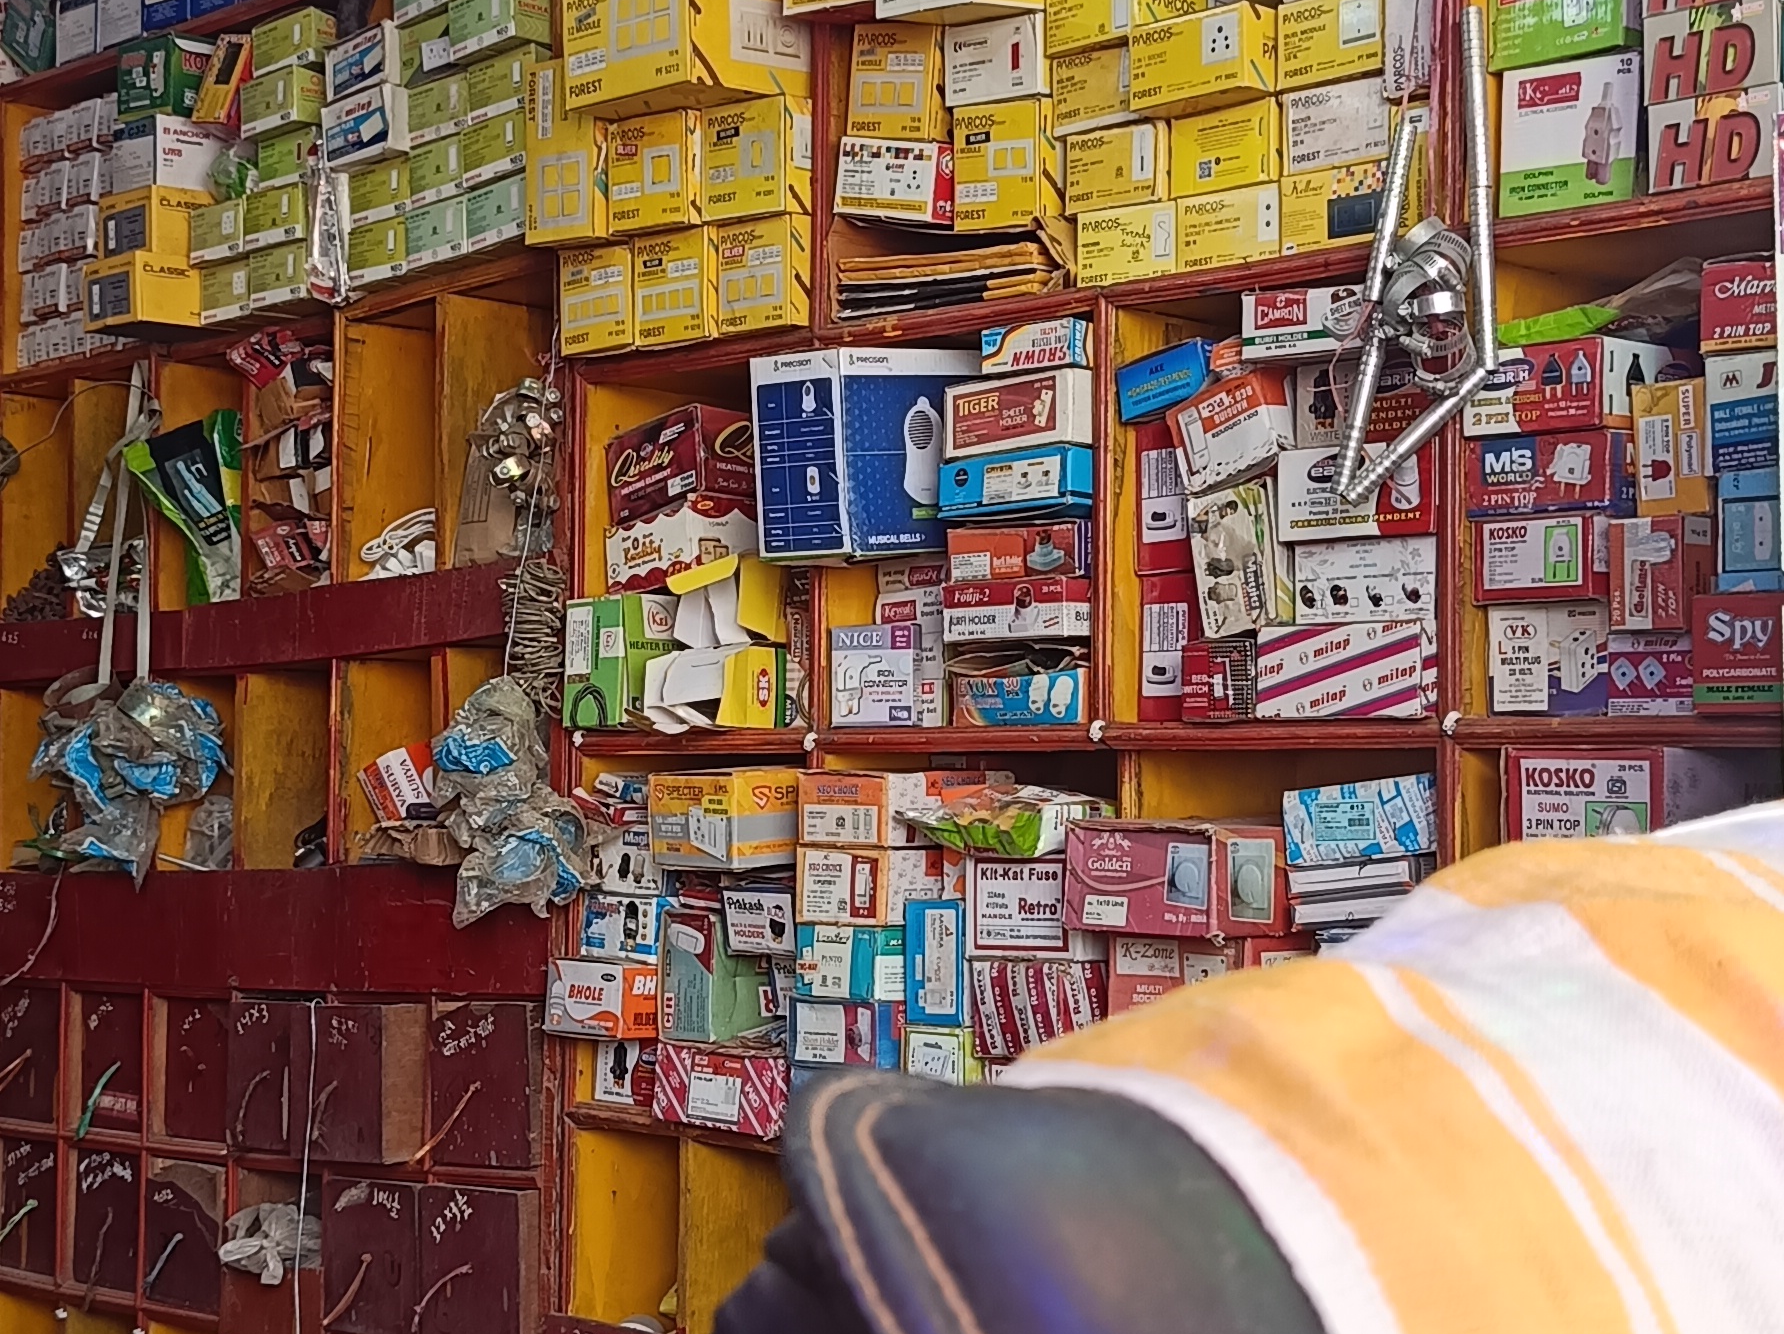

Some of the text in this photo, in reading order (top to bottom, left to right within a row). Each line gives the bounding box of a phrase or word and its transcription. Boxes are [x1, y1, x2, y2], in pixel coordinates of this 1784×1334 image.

[517, 0, 549, 14] SHIKHA
[1282, 5, 1324, 25] PARCOS
[496, 26, 509, 36] NEO
[567, 25, 575, 37] 12
[1132, 26, 1173, 47] PARCOS
[857, 33, 897, 46] PARCOS
[1619, 58, 1633, 67] 10
[1650, 22, 1755, 105] HD
[1284, 65, 1314, 79] FOREST
[569, 78, 603, 99] FOREST
[1132, 86, 1162, 101] FOREST
[527, 71, 537, 124] FOREST
[345, 97, 373, 118] milap
[851, 121, 882, 133] FOREST
[954, 114, 995, 131] PARCOS
[173, 128, 211, 142] ANCHOR
[1655, 110, 1761, 190] HD
[510, 154, 524, 165] NEO
[1292, 151, 1321, 165] FOREST
[1523, 170, 1554, 181] DOLPHIN
[1509, 180, 1569, 195] IRON CONNECTOR
[1583, 190, 1614, 200] DOLPHIN
[394, 201, 407, 212] NEO
[1184, 200, 1225, 216] PARCOS
[1082, 218, 1121, 233] PARCOS
[390, 263, 403, 274] NEO
[1184, 256, 1213, 268] FOREST
[143, 263, 191, 278] CLASSIC
[1080, 274, 1108, 285] FOREST
[1257, 303, 1304, 326] CAMRON
[1330, 302, 1348, 316] SHEET
[1713, 322, 1771, 339] 2 PIN TOP
[1255, 332, 1309, 345] BURFI HOLDER
[781, 358, 812, 370] PRECISION
[856, 354, 889, 364] PRECISION
[956, 392, 999, 417] TIGER
[1201, 395, 1226, 415] P.C.
[1372, 397, 1412, 408] MULTI
[1681, 388, 1691, 426] SUPER
[1002, 406, 1025, 418] SHEET
[1472, 410, 1541, 426] 2 PIN TOP
[1000, 414, 1028, 427] HOLDER
[1309, 429, 1340, 440] WHITE
[716, 462, 748, 474] HEATING
[1486, 472, 1532, 483] WORLD
[1482, 492, 1537, 508] 2 PIN TOP
[1290, 511, 1422, 529] PREMIUM PENDENT
[868, 533, 921, 545] MUSICAL BELLS
[1488, 525, 1528, 541] KOSKO
[1668, 590, 1677, 616] TOP
[968, 614, 997, 626] HOLDER
[1707, 611, 1773, 649] Spy
[629, 639, 661, 651] HEATER
[838, 631, 883, 647] NICE
[1643, 636, 1679, 648] milap
[1313, 634, 1351, 659] milap
[1517, 645, 1530, 655] PIN
[1500, 655, 1541, 666] MULTI PLUG
[876, 669, 895, 678] IRON
[1192, 674, 1208, 683] BED
[1377, 661, 1418, 686] milap
[1702, 667, 1777, 678] POLYCARBONATE
[759, 674, 769, 703] SK
[863, 679, 908, 689] CONNECTOR
[1706, 684, 1774, 693] MALE FEMALE
[1309, 685, 1347, 710] milap
[1627, 763, 1645, 773] PCS.
[400, 758, 423, 800] SURYA
[1525, 767, 1595, 789] KOSKO
[383, 764, 407, 808] SURYA
[666, 785, 704, 798] SPECTER
[817, 784, 859, 795] NEO CHOICE
[1526, 789, 1596, 797] ELECTRICAL SOLUTION
[1537, 802, 1569, 814] SUMO
[1526, 818, 1581, 831] 3 PIN TOP
[823, 863, 843, 873] CHOICE
[1088, 857, 1132, 871] Golden
[1028, 867, 1059, 881] Fuse
[726, 896, 765, 915] Prakash
[1018, 897, 1058, 916] Retro
[766, 907, 786, 920] BLACK
[733, 928, 766, 940] HOLDERS
[1121, 943, 1175, 961] K-Zone
[568, 983, 605, 1001] BHOLE
